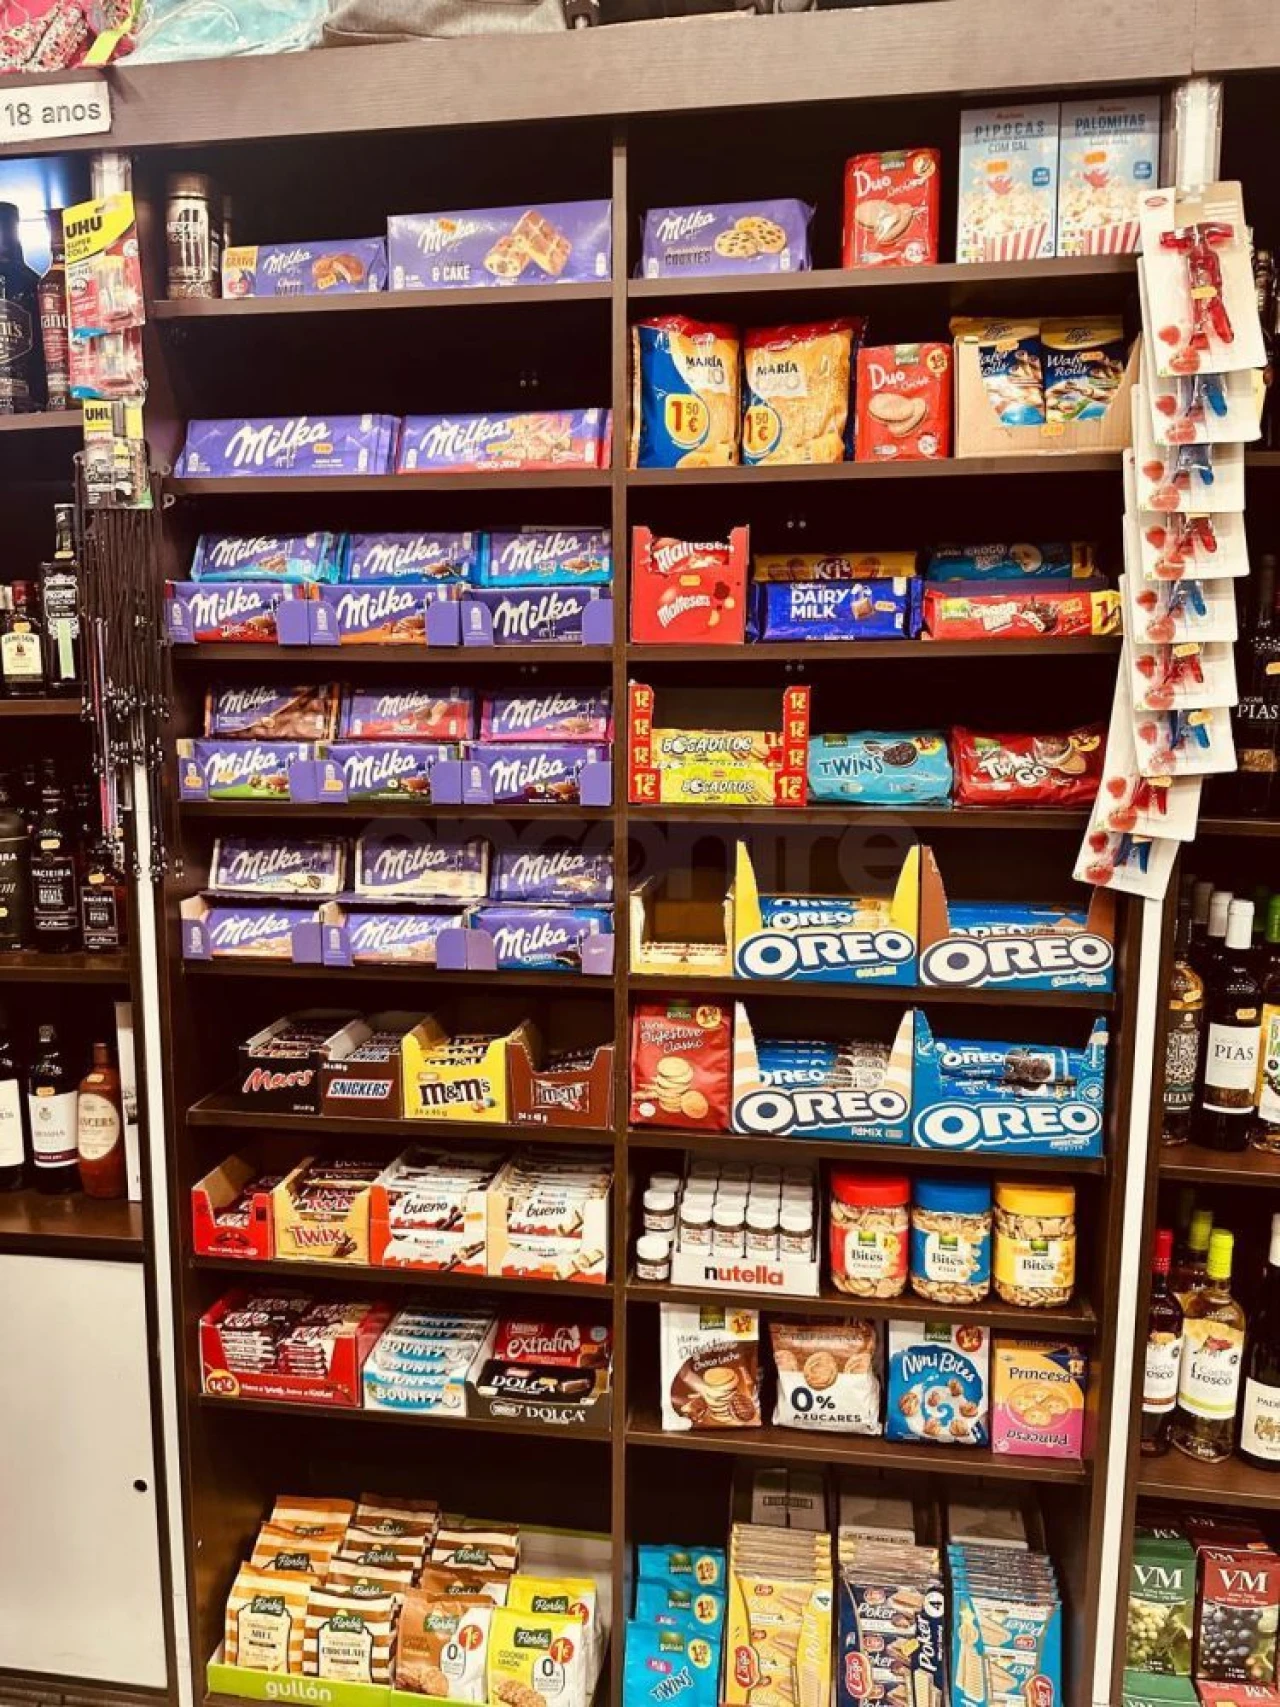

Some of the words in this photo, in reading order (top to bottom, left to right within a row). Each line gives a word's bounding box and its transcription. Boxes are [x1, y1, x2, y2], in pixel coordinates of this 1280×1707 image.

[5, 102, 31, 126] 18
[42, 102, 102, 124] anos
[1075, 113, 1146, 131] PALOMITAS
[975, 120, 1045, 137] PIPOCAS
[853, 170, 891, 197] Duo
[66, 216, 103, 238] UHU
[656, 210, 718, 243] Milka
[263, 247, 312, 274] Milka
[444, 264, 471, 281] CAKE
[686, 355, 723, 369] MARÍA
[756, 360, 799, 376] MARÍA
[868, 363, 905, 390] Duo
[224, 416, 332, 467] Milka
[419, 417, 508, 460] Milka
[209, 536, 279, 568] Milka
[363, 536, 442, 574] Milka
[500, 532, 582, 572] Milka
[189, 586, 263, 628] Milka
[336, 585, 416, 630] Milka
[790, 587, 849, 605] DAIRY
[493, 591, 583, 638] Milka
[790, 604, 837, 620] MILK
[218, 686, 280, 715] Milka
[377, 691, 431, 718] Milka
[500, 692, 581, 731] Milka
[1236, 704, 1280, 720] PIAS
[204, 747, 279, 787] Milka
[343, 749, 418, 789] Milka
[489, 754, 567, 794] Milka
[819, 756, 884, 778] TWINS
[229, 847, 303, 880] Milka
[373, 844, 448, 880] Milka
[511, 849, 586, 885] Milka
[210, 913, 292, 946] Milka
[351, 916, 429, 949] Milka
[493, 922, 570, 960] Milka
[740, 931, 914, 981] OREO
[924, 936, 1112, 985] OREO
[942, 1052, 1004, 1067] OREO
[1213, 1043, 1255, 1062] PIAS
[241, 1067, 314, 1094] Mars
[330, 1080, 390, 1098] SNICKERS
[419, 1077, 491, 1107] m&m's
[738, 1090, 908, 1135] OREO
[920, 1104, 1100, 1147] OREO
[403, 1201, 448, 1215] bueno
[526, 1203, 567, 1218] bueno
[292, 1226, 345, 1246] Twix
[851, 1249, 884, 1262] Bites
[931, 1252, 965, 1266] Bites
[1022, 1259, 1056, 1272] Bites
[704, 1265, 784, 1286] nutella
[903, 1352, 938, 1382] Mini
[938, 1352, 976, 1383] Bites
[1009, 1366, 1073, 1385] Princesa
[376, 1386, 436, 1404] BOUNTY
[1005, 1428, 1068, 1446] Princesa
[1133, 1564, 1184, 1590] VM
[1218, 1568, 1269, 1594] VM
[857, 1602, 899, 1620] Poker
[915, 1615, 940, 1673] Poker
[867, 1652, 897, 1669] oker
[264, 1680, 333, 1703] gullón
